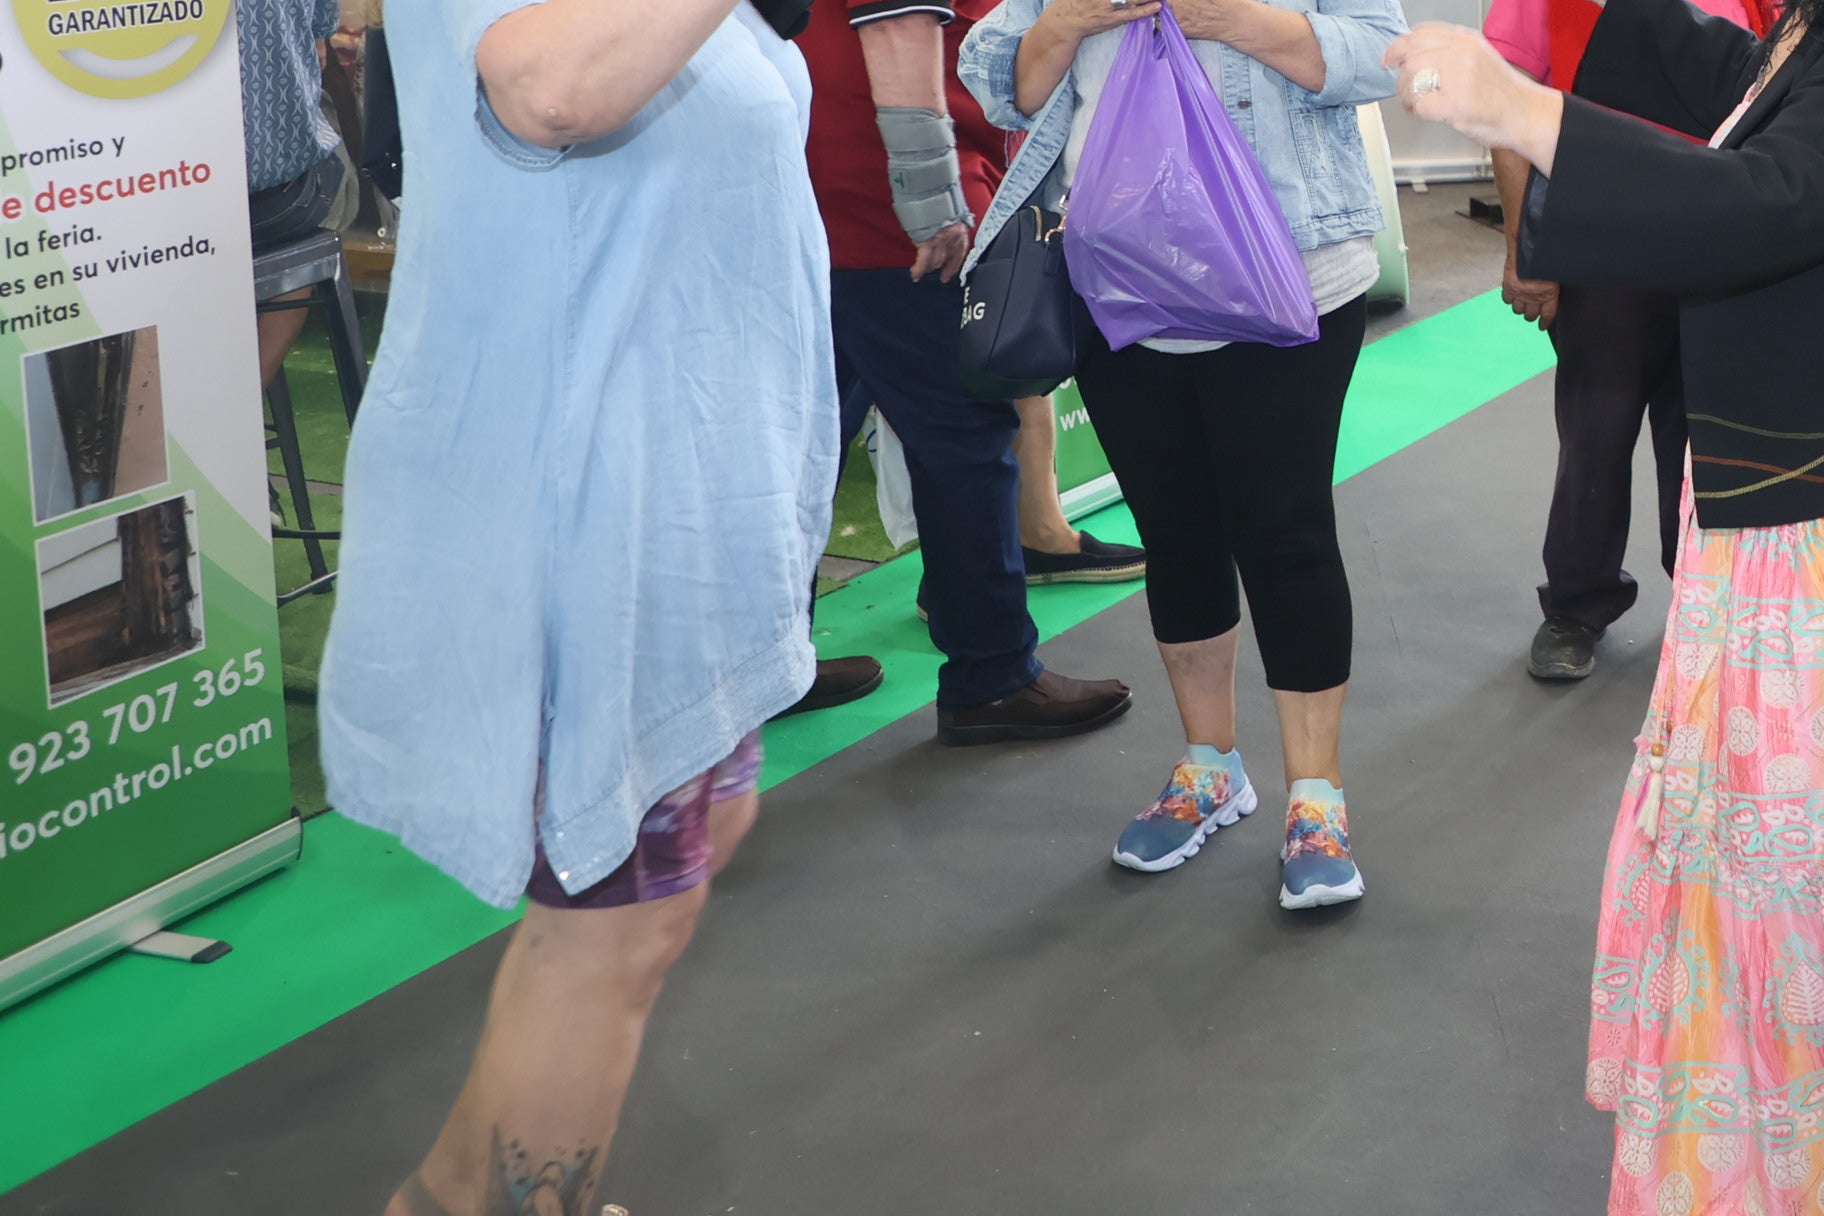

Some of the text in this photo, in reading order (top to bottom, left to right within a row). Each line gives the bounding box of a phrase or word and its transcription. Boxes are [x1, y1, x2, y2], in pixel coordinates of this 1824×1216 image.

[2, 136, 126, 177] promiso y
[34, 159, 212, 214] descuento
[5, 224, 103, 260] la feria.
[34, 268, 65, 290] en
[73, 261, 99, 282] su
[106, 235, 216, 275] vivienda,
[8, 646, 266, 786] 923 707 365
